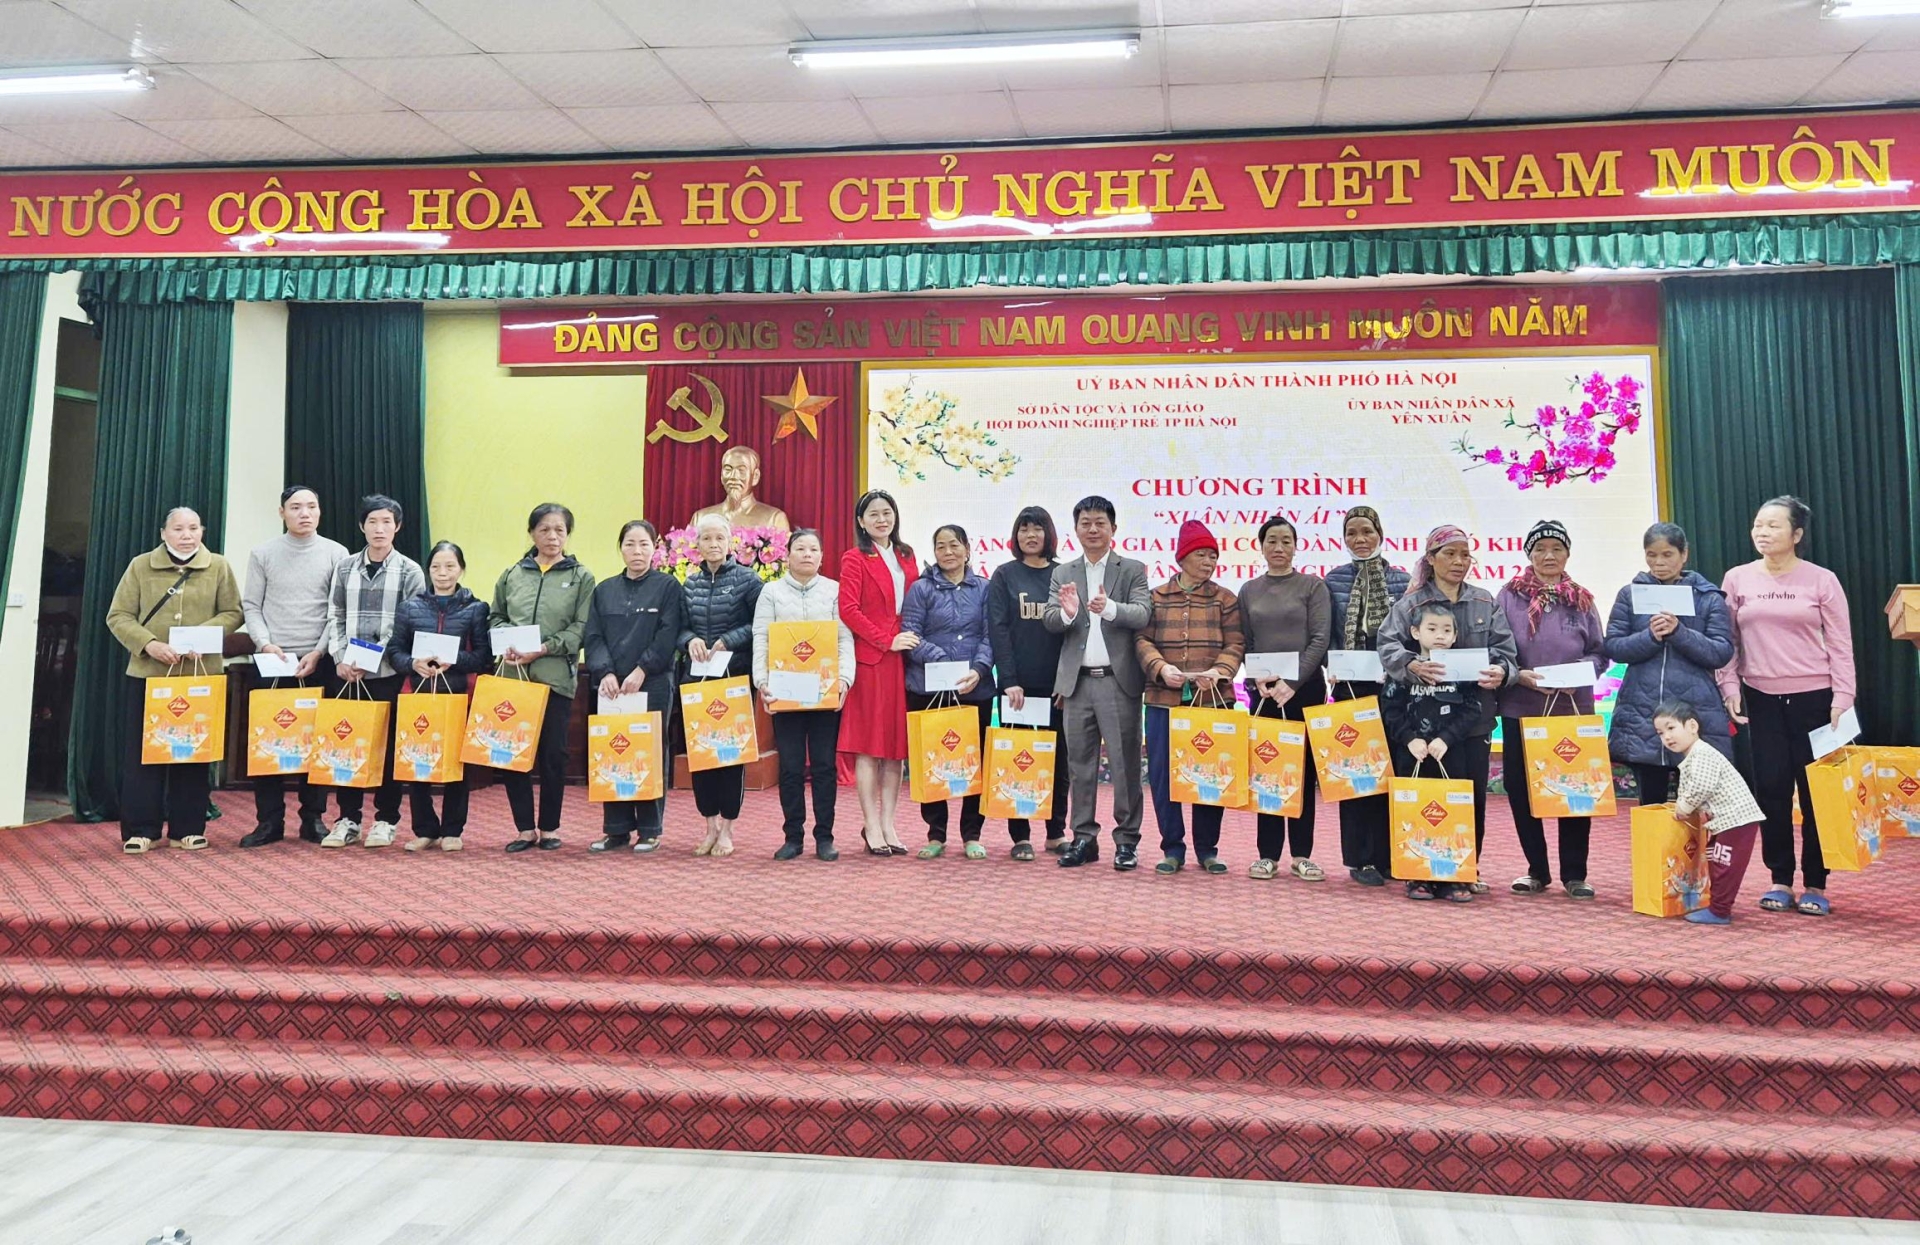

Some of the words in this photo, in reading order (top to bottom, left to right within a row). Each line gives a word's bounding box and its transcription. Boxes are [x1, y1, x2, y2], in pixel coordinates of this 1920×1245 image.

[8, 176, 182, 236] NƯỚC
[208, 177, 385, 247] CỘNG
[406, 171, 542, 231] HÒA
[566, 171, 662, 226] XÃ
[681, 165, 803, 239] HỘI
[829, 154, 969, 222] CHỦ
[992, 153, 1224, 217] NGHĨA
[1245, 145, 1420, 219] VIỆT
[1449, 151, 1624, 202] NAM
[1650, 126, 1895, 195] MUÔN
[553, 311, 659, 353] ĐẢNG
[673, 313, 779, 358] CỘNG
[793, 307, 870, 348] SẢN
[884, 310, 966, 356] VIỆT
[980, 315, 1067, 346] NAM
[1081, 311, 1220, 345] QUANG
[1235, 309, 1331, 341] VINH
[1348, 299, 1473, 340] MUÔN
[1490, 297, 1588, 336] NĂM
[1109, 377, 1147, 390] BAN
[1153, 374, 1208, 389] NHÂN
[1214, 373, 1255, 388] DÂN
[1261, 371, 1332, 387] THÀNH
[1386, 370, 1414, 386] HÀ
[1421, 371, 1457, 388] NỘI
[1040, 402, 1070, 415] DÂN
[1107, 402, 1126, 414] VÀ
[1132, 401, 1161, 413] TÔN
[1372, 400, 1403, 410] BAN
[1407, 396, 1453, 409] NHÂN
[1457, 396, 1490, 409] DÂN
[1493, 396, 1516, 408] XÃ
[986, 418, 1013, 431] HỘI
[1017, 419, 1069, 429] DOANH
[1164, 418, 1181, 428] TP
[1184, 415, 1205, 427] HÀ
[1391, 411, 1423, 424] YÊN
[1427, 411, 1471, 424] XUÂN
[1132, 475, 1264, 496] CHƯƠNG
[1271, 473, 1368, 495] TRÌNH
[1122, 537, 1163, 551] GIA
